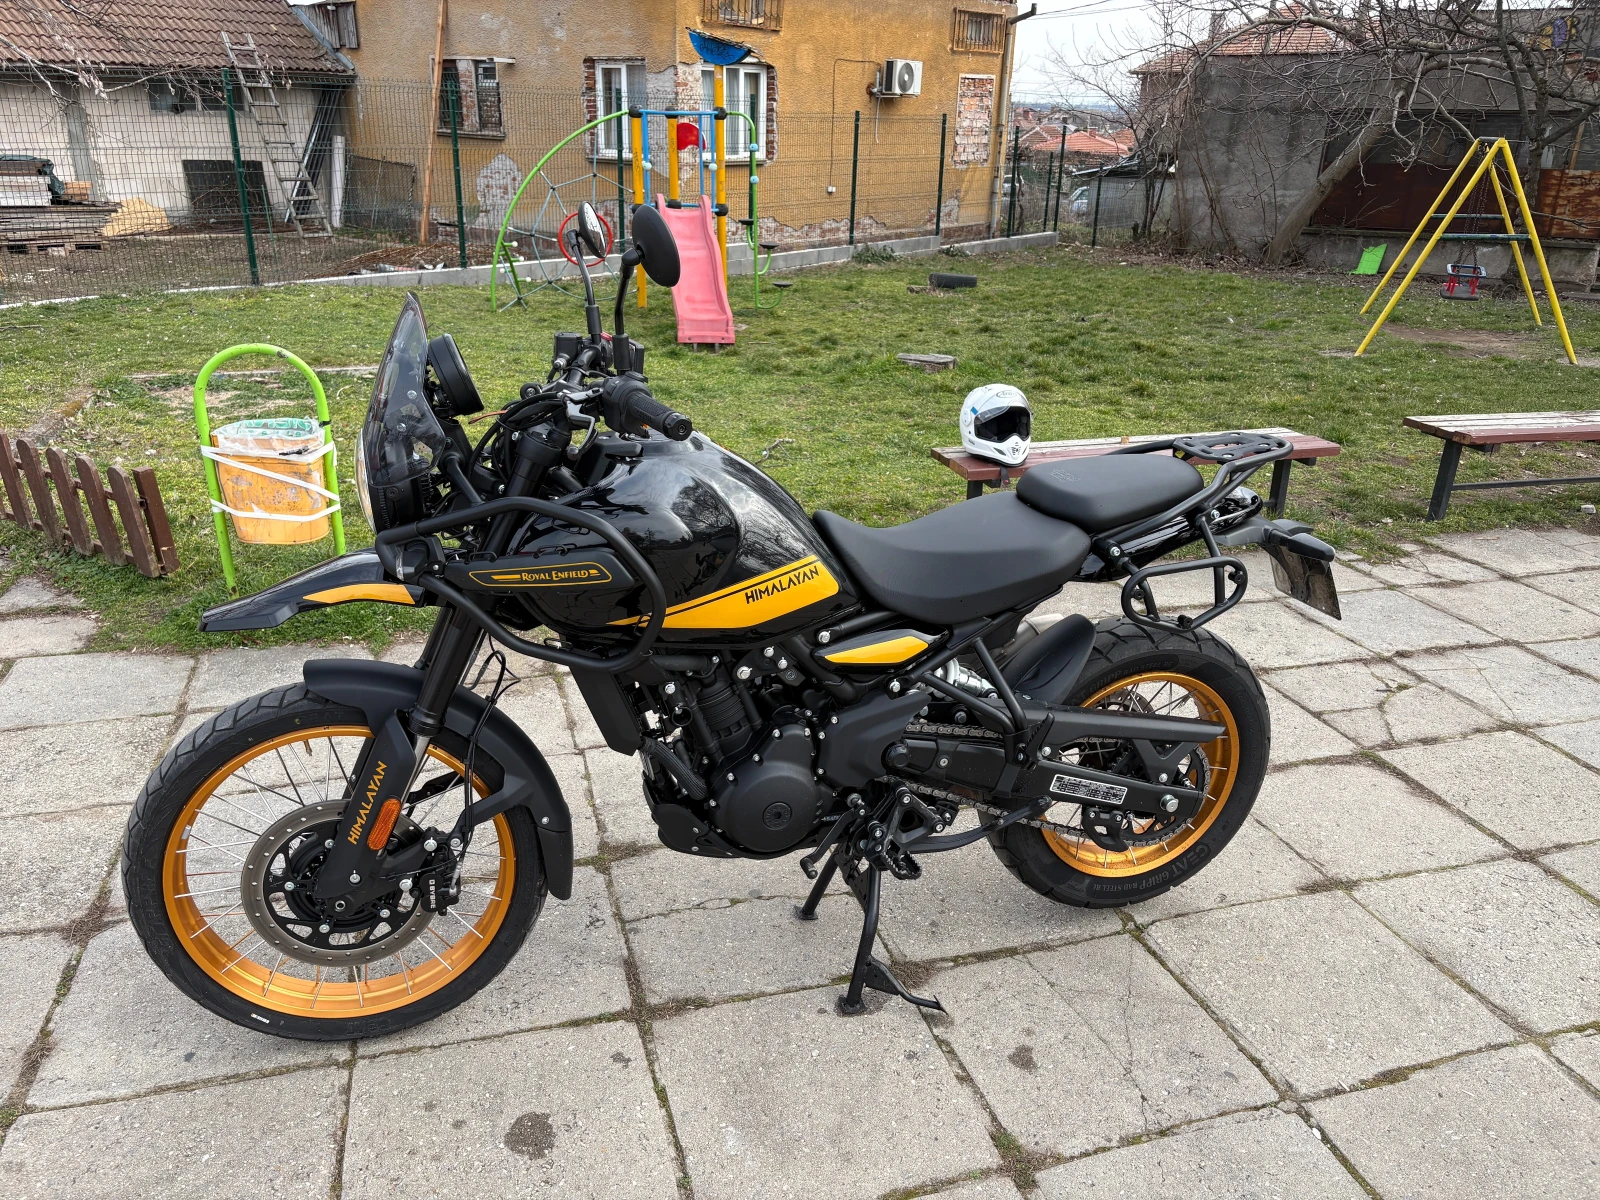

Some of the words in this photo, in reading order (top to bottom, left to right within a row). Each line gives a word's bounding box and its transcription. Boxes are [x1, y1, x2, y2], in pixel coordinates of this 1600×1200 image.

[521, 572, 551, 582] ROYAL
[551, 570, 589, 581] ENFIELD
[744, 565, 820, 605] HIMALAYAN
[347, 760, 388, 845] HIMALAYAN
[1170, 844, 1208, 877] CEAT
[1102, 883, 1123, 892] STEEL
[1139, 871, 1170, 890] GRIPP
[429, 885, 437, 909] BYBRE
